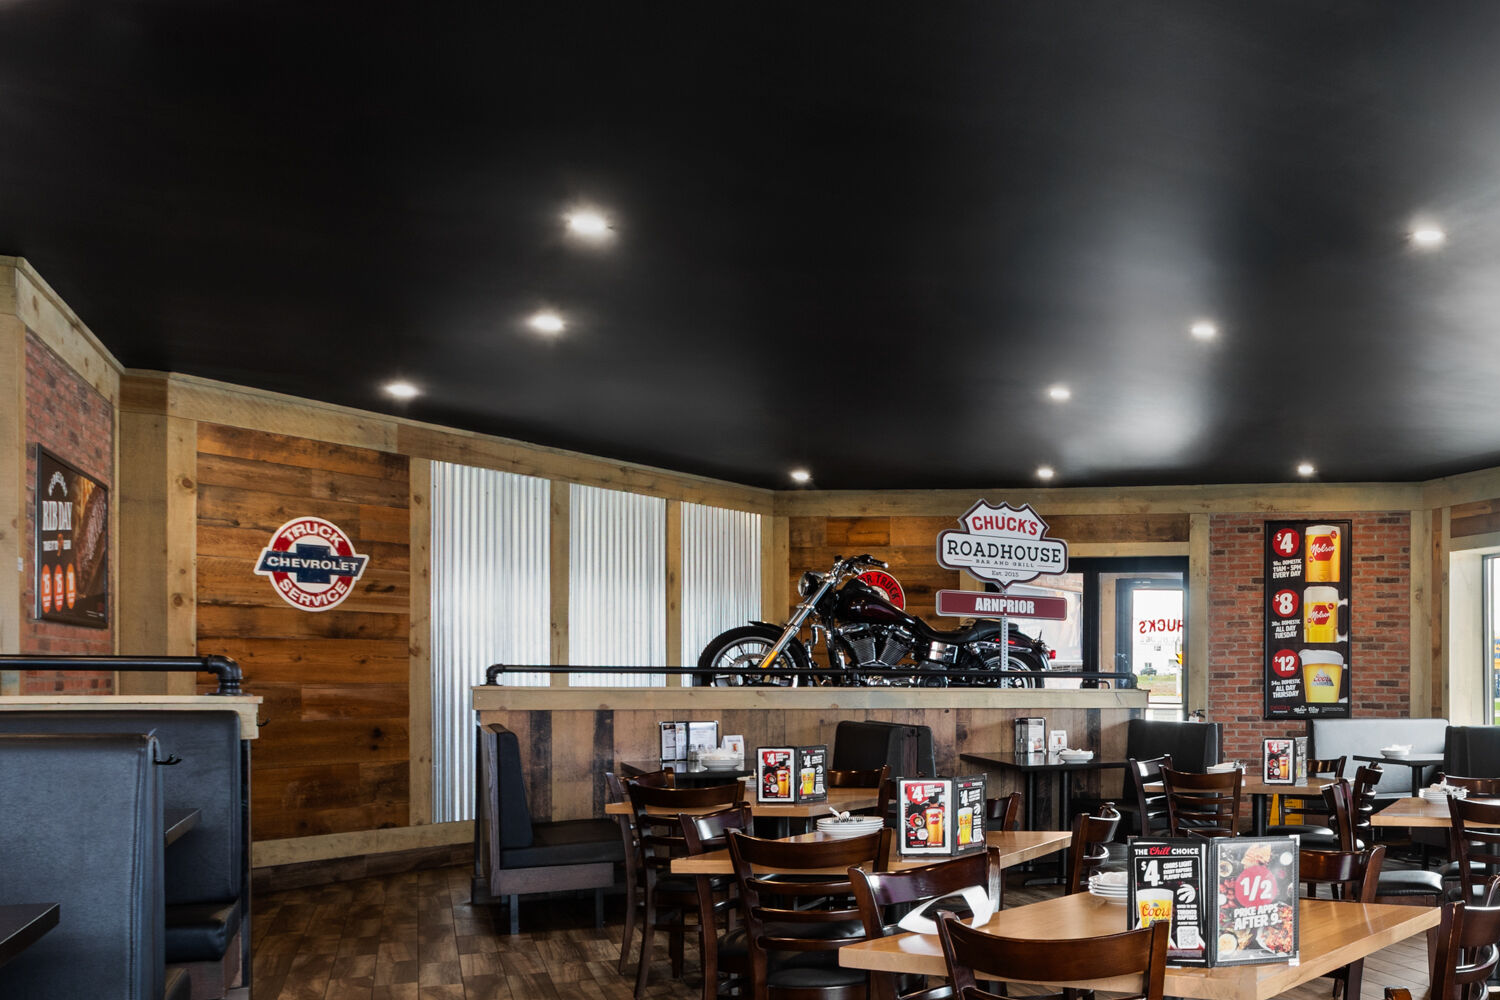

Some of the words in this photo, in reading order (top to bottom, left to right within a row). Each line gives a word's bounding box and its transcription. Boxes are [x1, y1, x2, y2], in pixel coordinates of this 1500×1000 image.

[42, 501, 58, 530] RIB
[58, 502, 72, 530] DAY
[972, 516, 1038, 535] CHUCK'S
[281, 522, 344, 548] TRUCK
[947, 540, 1060, 563] ROADHOUSE
[1310, 544, 1335, 556] Molson
[267, 556, 359, 571] CHEVROLET
[1004, 570, 1020, 578] 2015
[279, 578, 348, 606] SERVICE
[876, 574, 900, 600] TRUCK
[975, 598, 1034, 614] ARNPRIOR
[1310, 610, 1330, 620] Molson
[1275, 631, 1297, 639] TUESDAY
[1273, 690, 1299, 698] THURSDAY
[1149, 846, 1171, 855] Chill
[1141, 860, 1160, 886] $4
[1240, 876, 1272, 902] 1/2
[1142, 904, 1170, 917] Coors
[1234, 906, 1256, 918] PRICE
[1258, 903, 1278, 915] APPS
[1234, 916, 1268, 930] AFTER
